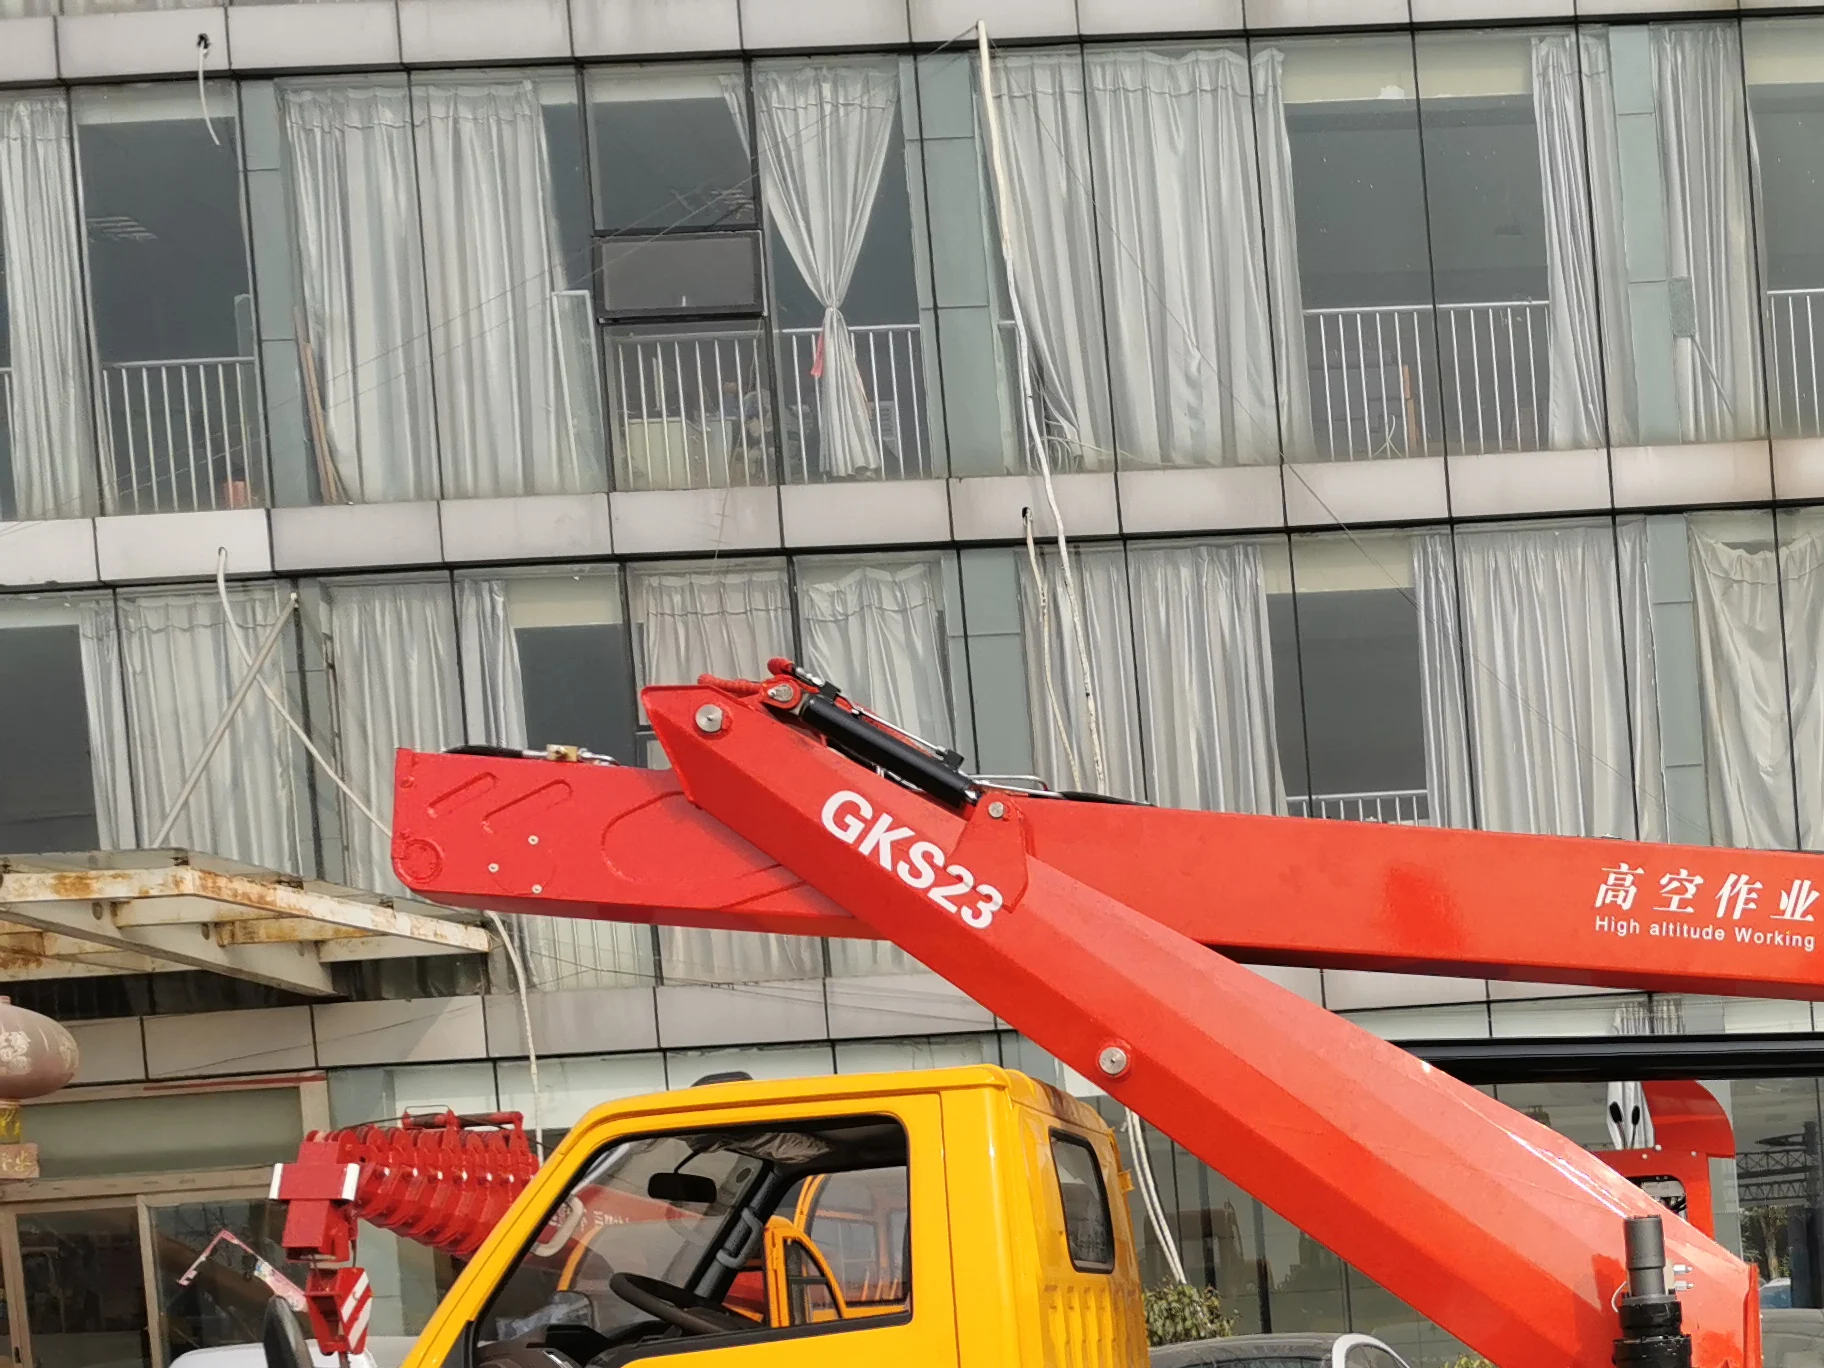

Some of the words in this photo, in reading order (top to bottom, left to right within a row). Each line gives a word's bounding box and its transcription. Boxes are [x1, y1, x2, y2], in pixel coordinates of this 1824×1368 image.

[821, 790, 1003, 928] GKS23
[1595, 915, 1640, 937] High
[1649, 921, 1726, 941] altitude
[1734, 926, 1816, 952] Working
